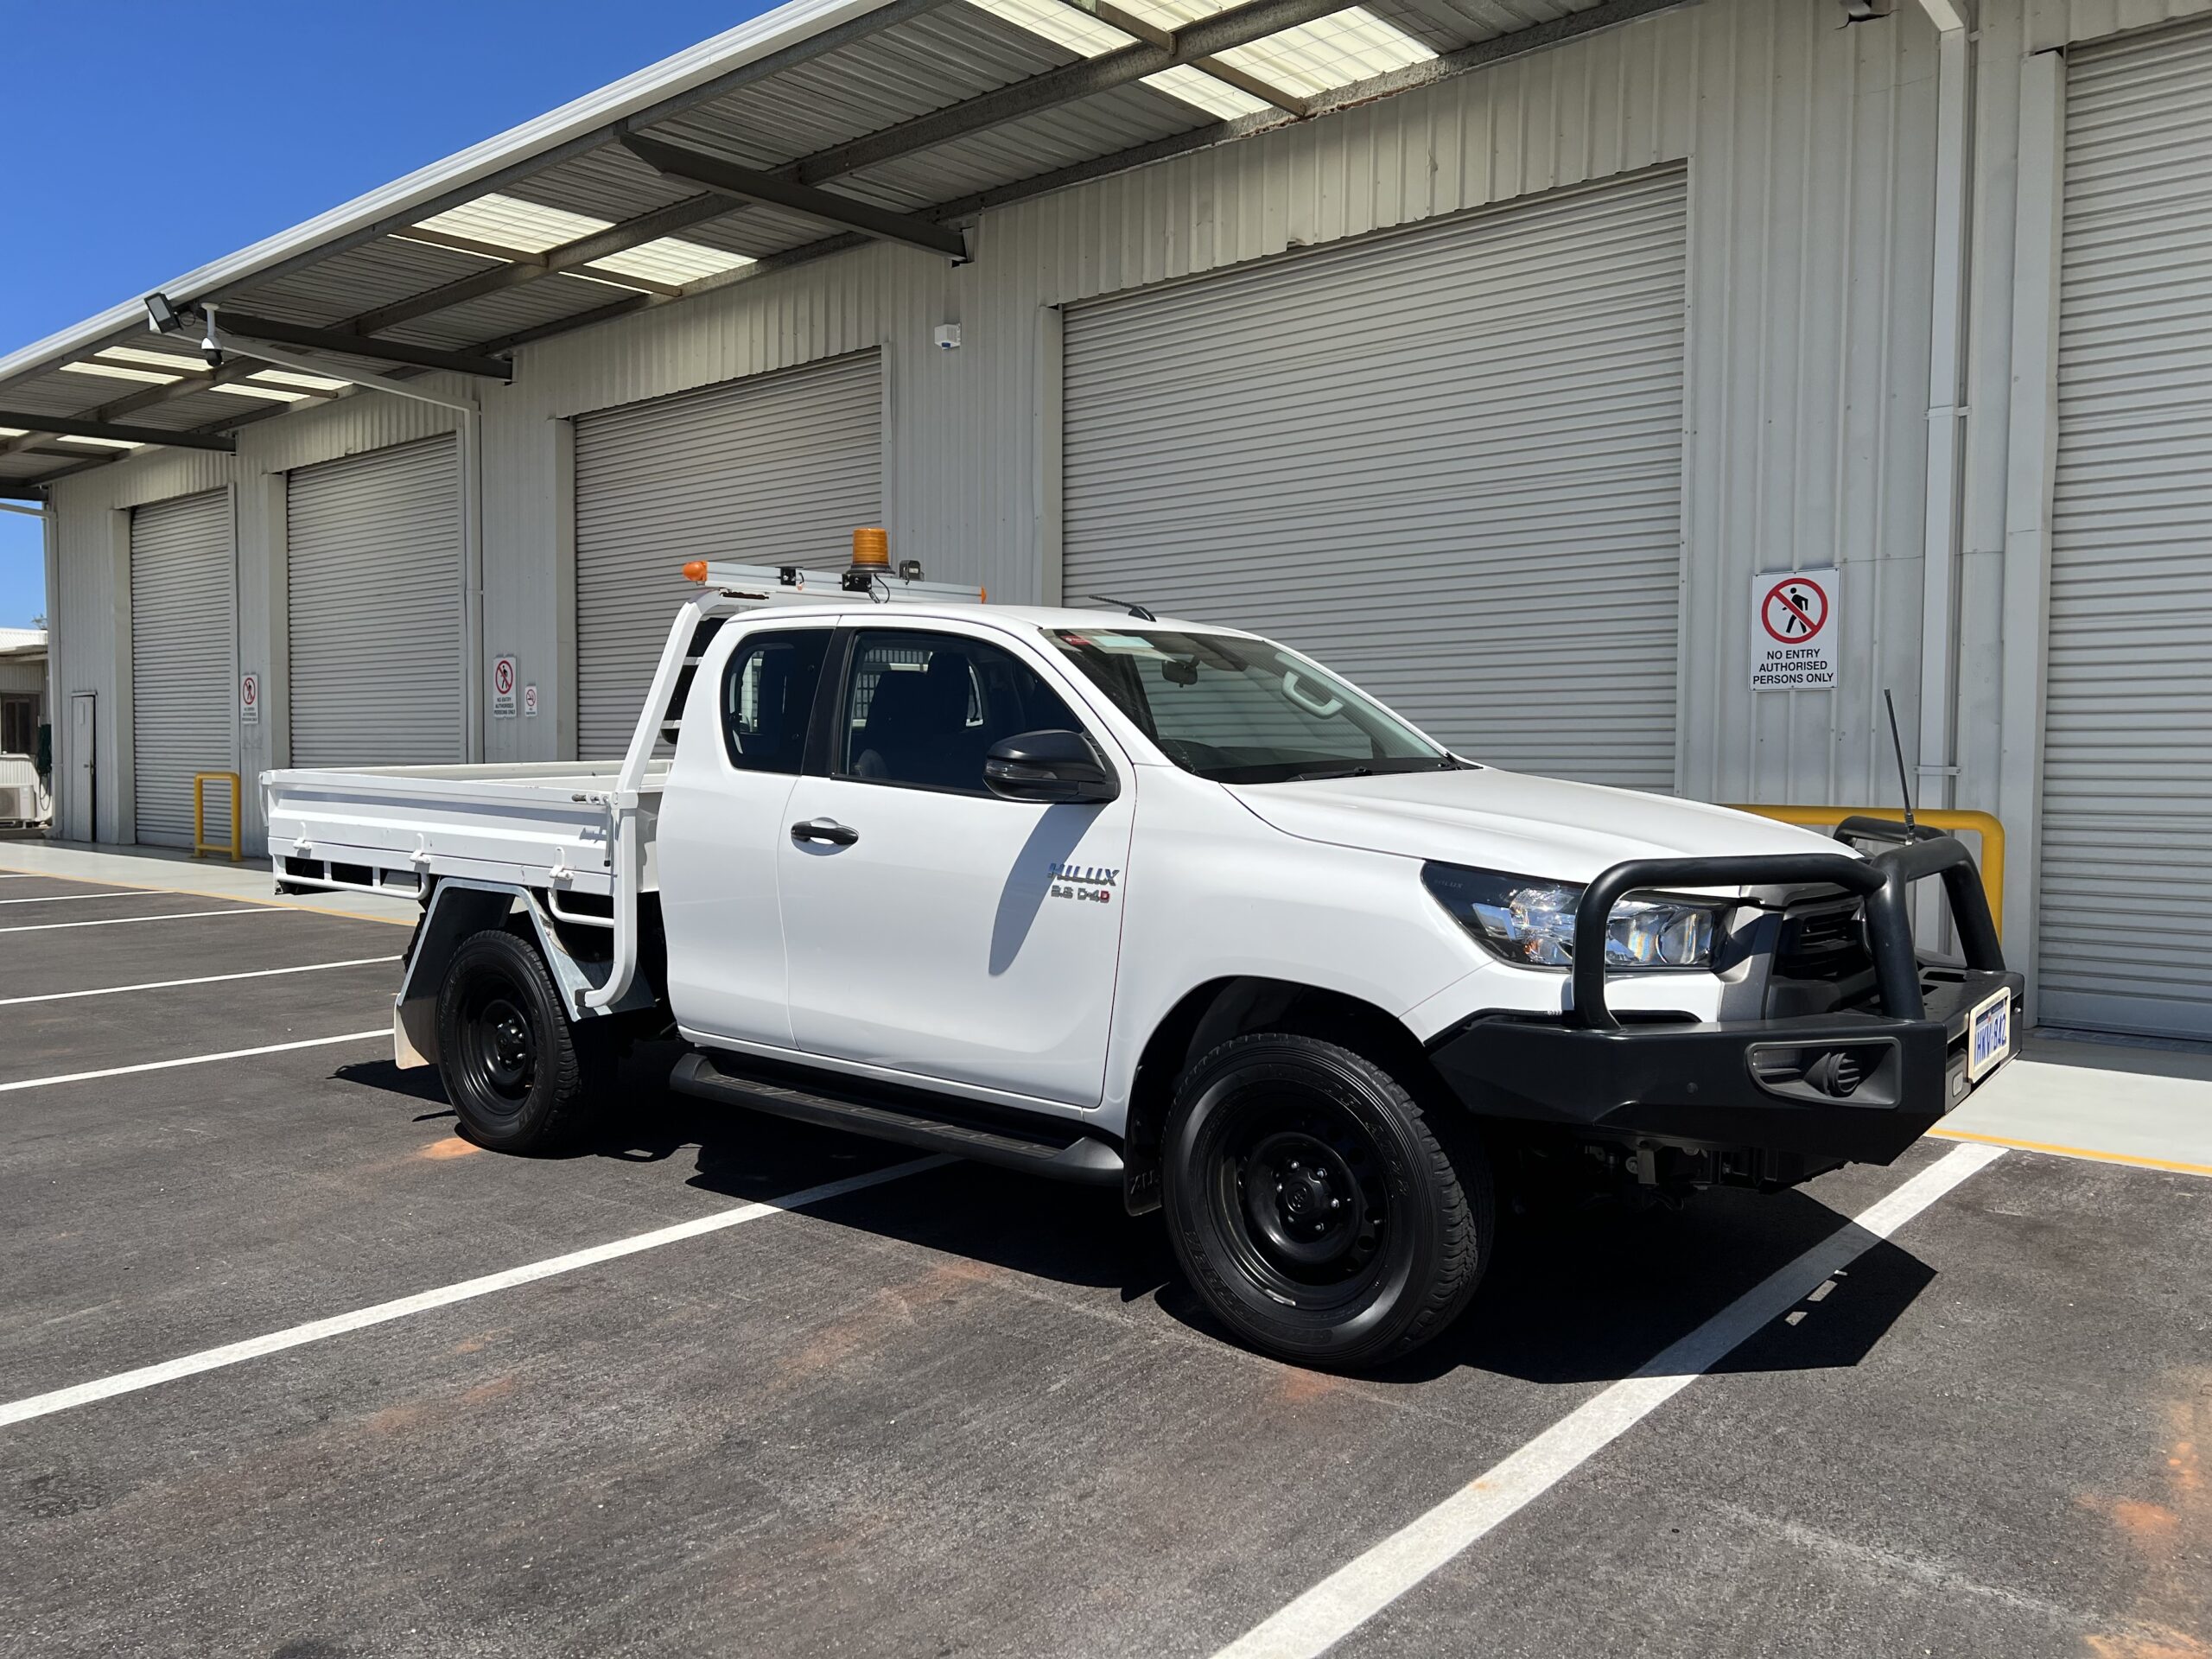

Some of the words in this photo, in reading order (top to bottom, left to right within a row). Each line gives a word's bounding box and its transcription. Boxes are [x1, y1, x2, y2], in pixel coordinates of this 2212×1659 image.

[1767, 651, 1782, 659] NO
[1786, 649, 1820, 658] ENTRY
[1759, 661, 1827, 672] AUTHORISED
[1753, 675, 1803, 684] PERSONS
[1807, 673, 1834, 682] ONLY
[1047, 863, 1120, 887] HILUX
[1077, 887, 1109, 904] D-4D
